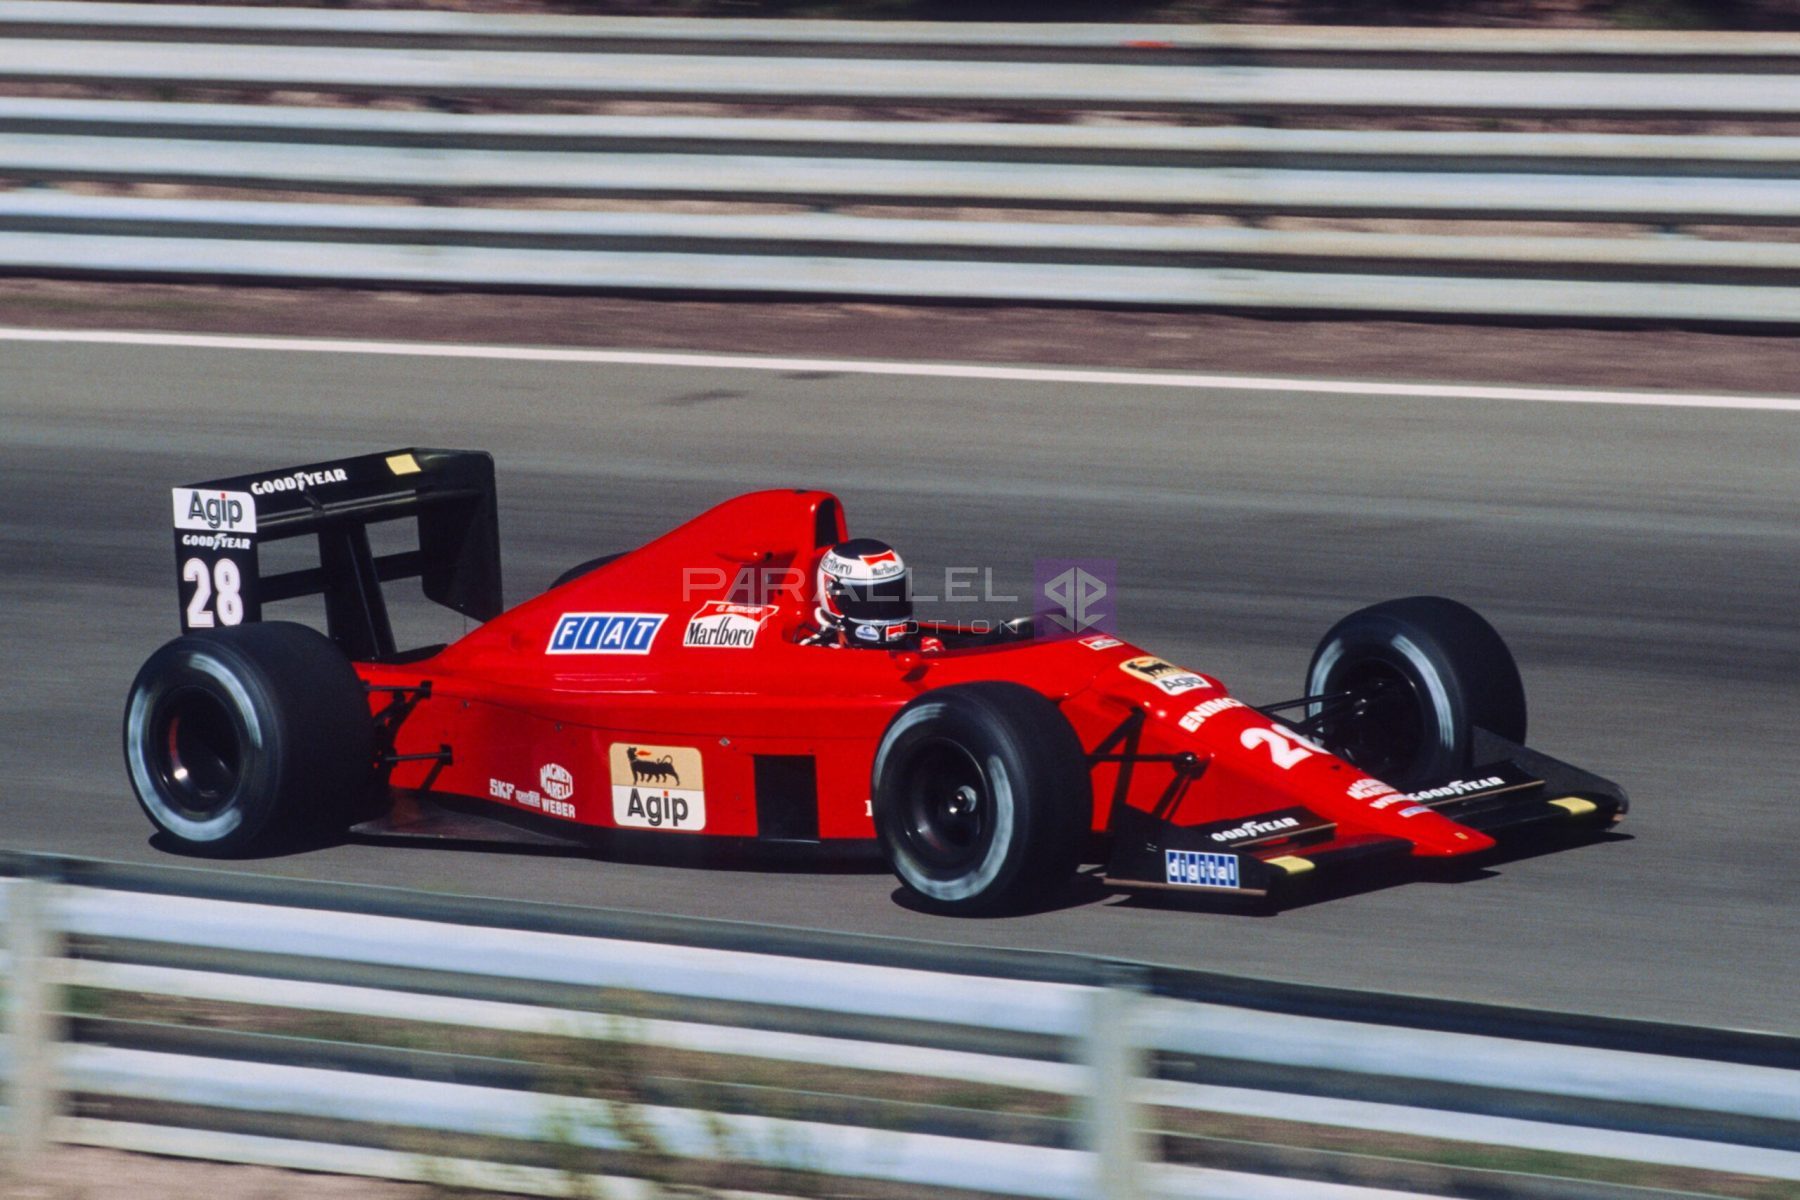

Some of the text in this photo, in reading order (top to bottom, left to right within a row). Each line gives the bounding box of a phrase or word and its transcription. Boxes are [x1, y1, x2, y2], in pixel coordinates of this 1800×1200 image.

[250, 468, 348, 496] GOODYEAR
[187, 490, 243, 529] Agip
[181, 533, 251, 550] GOODYEAR
[183, 557, 244, 628] 28
[558, 621, 654, 646] FIAT
[685, 616, 755, 647] Marlboro
[490, 778, 515, 800] SKF
[627, 787, 689, 827] Agip
[1210, 817, 1300, 842] OODYEAR
[1168, 858, 1236, 882] digital
